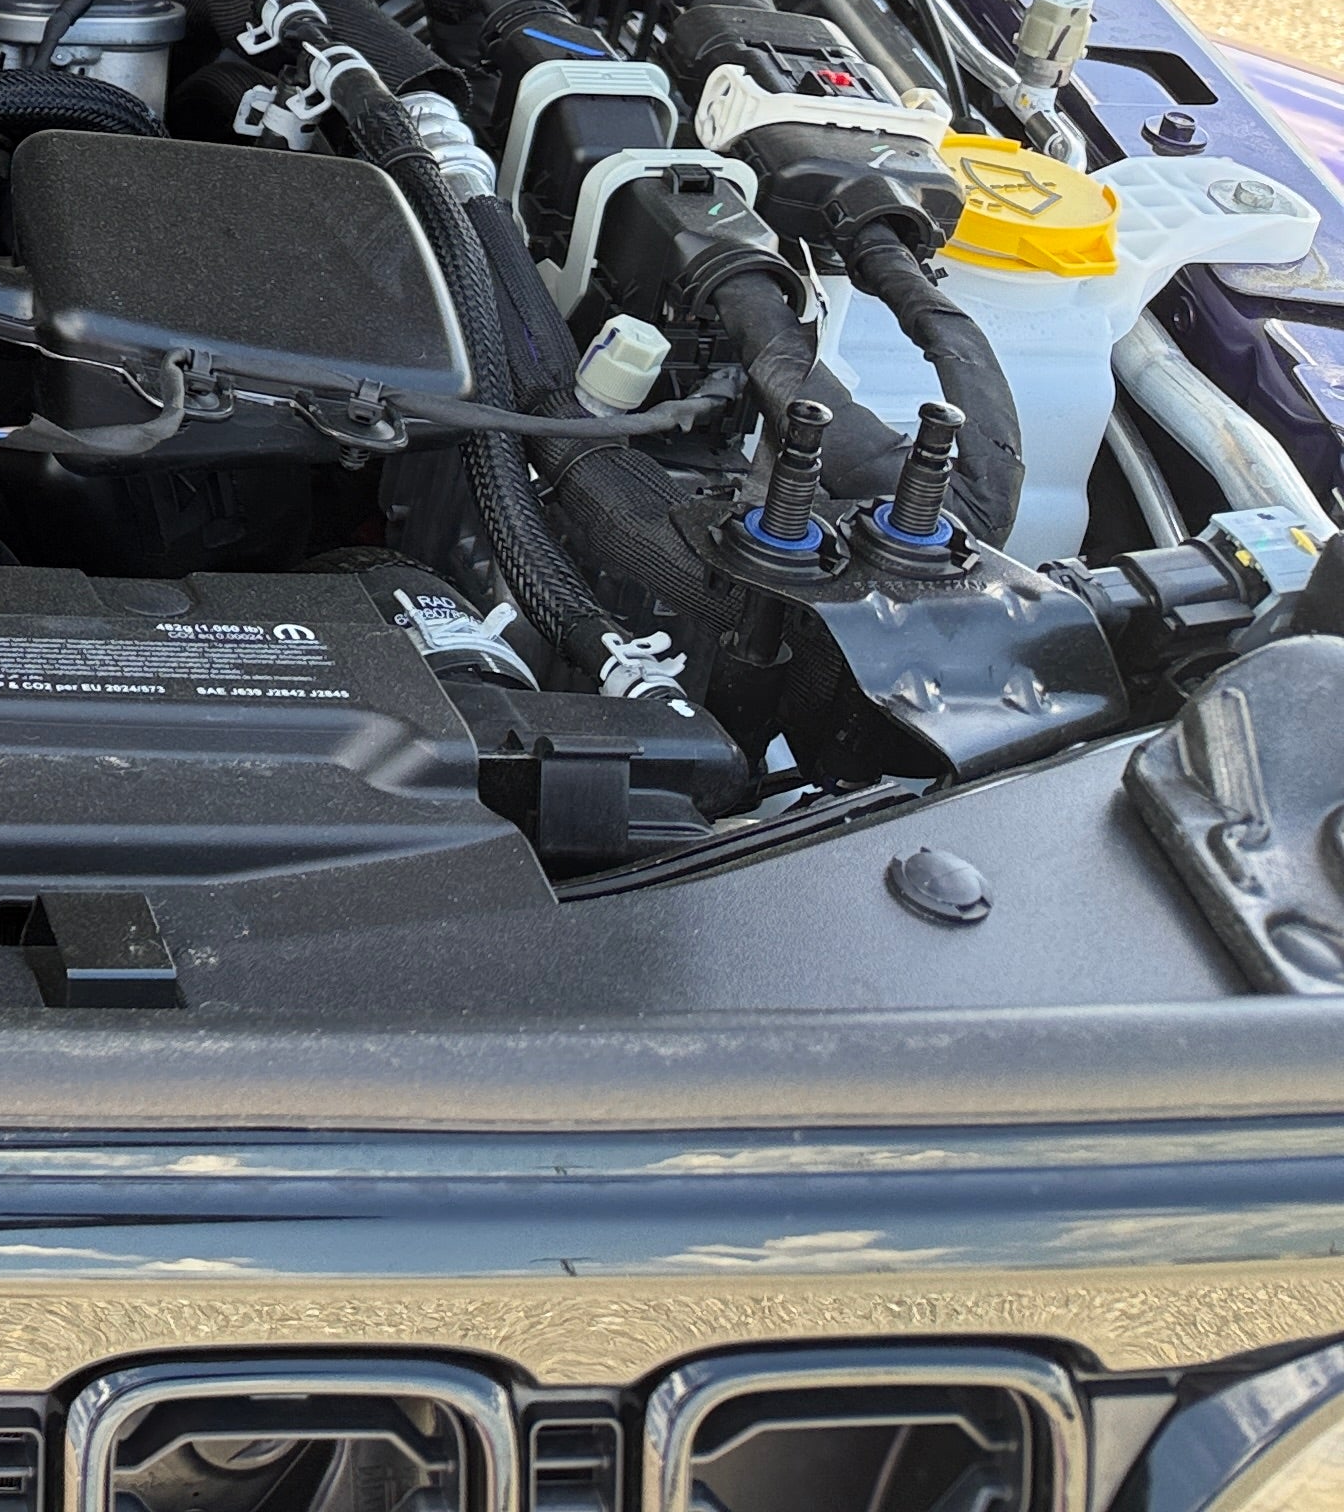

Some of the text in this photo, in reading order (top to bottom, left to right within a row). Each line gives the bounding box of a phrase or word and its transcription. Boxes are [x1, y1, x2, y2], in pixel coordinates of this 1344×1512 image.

[416, 595, 456, 608] RAD
[22, 681, 53, 691] CO2
[55, 684, 78, 692] per
[81, 683, 102, 692] EU
[196, 686, 228, 696] SAE
